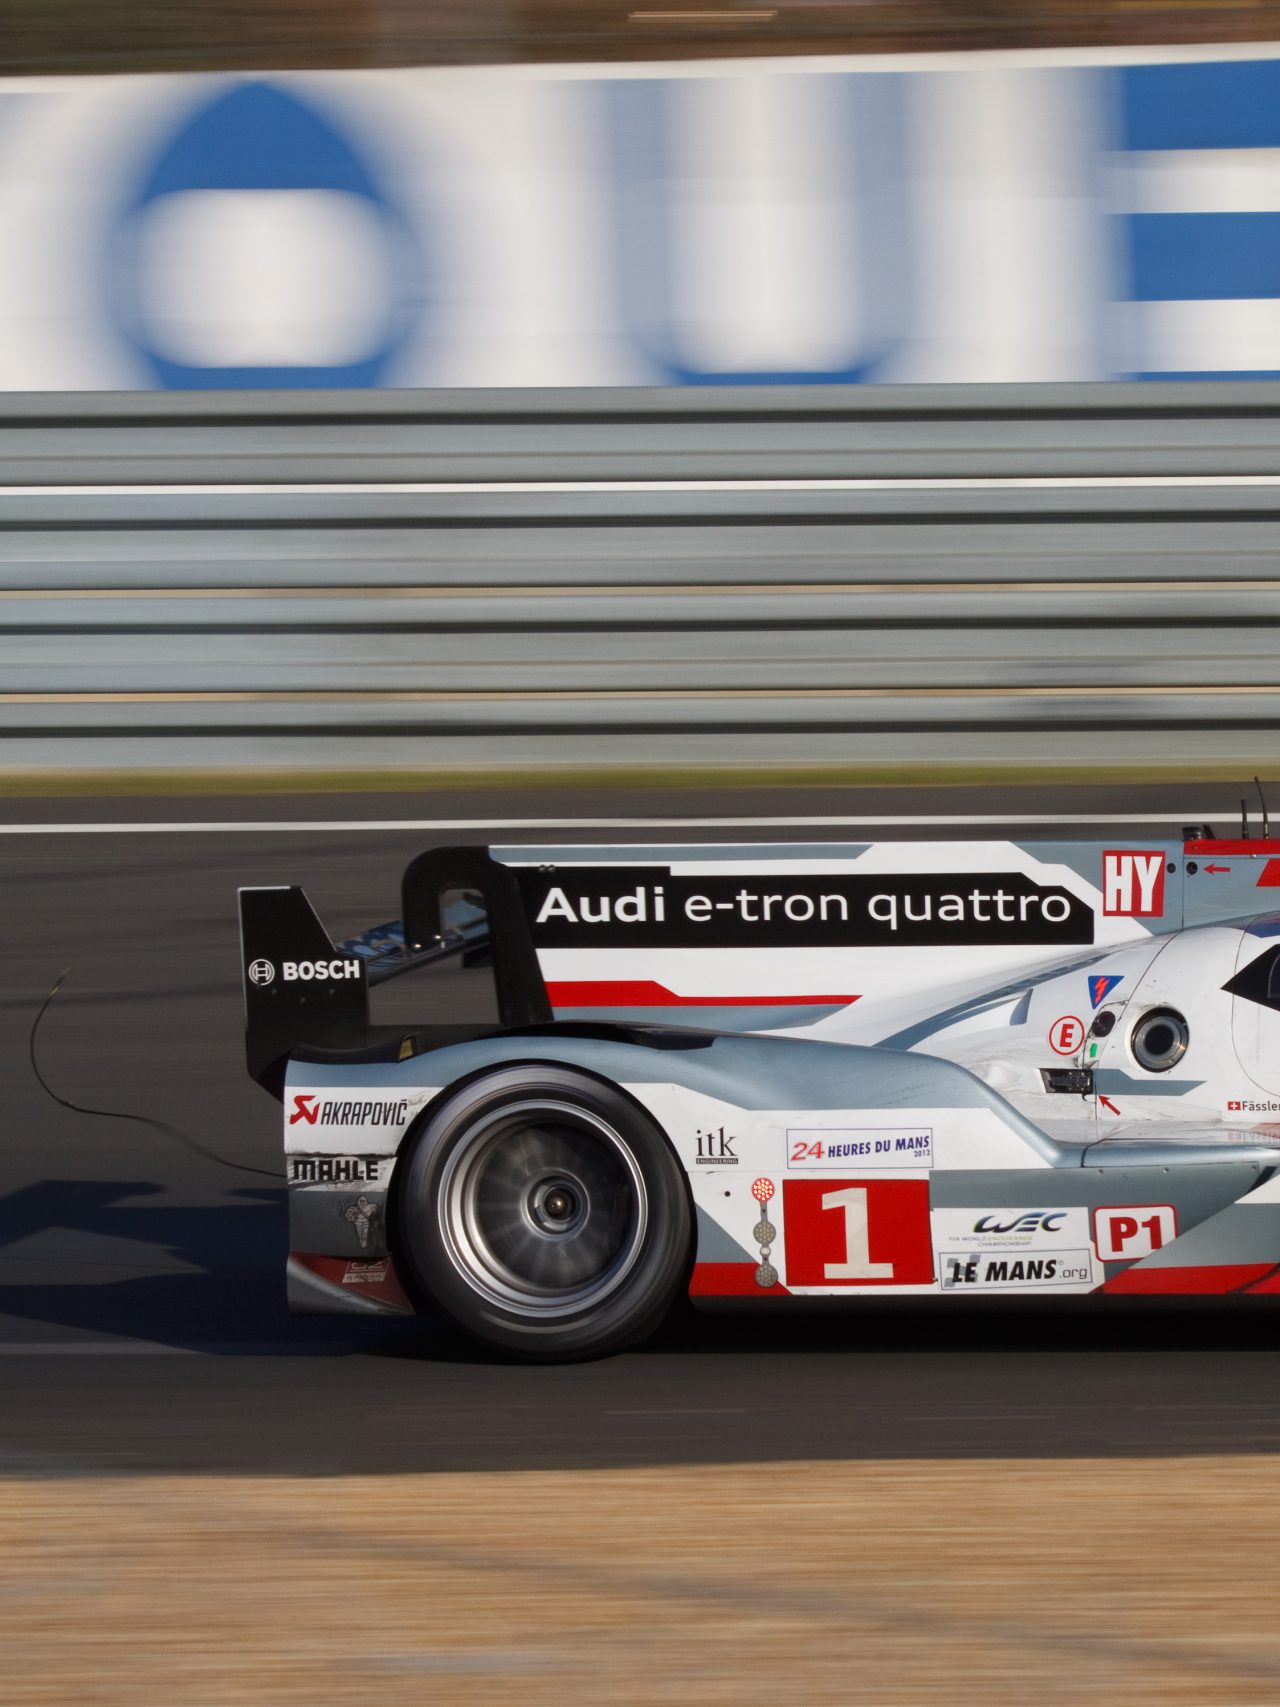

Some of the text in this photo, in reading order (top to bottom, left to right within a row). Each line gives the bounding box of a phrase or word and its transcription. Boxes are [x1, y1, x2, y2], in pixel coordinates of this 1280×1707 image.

[1105, 855, 1162, 912] HY
[536, 886, 1071, 930] Audi e-tron quattro
[283, 959, 360, 981] BOSCH
[1060, 1024, 1075, 1048] E
[695, 1126, 737, 1157] itk
[790, 1135, 930, 1161] 24 HEURES DU MANS
[914, 1149, 931, 1157] 2012
[293, 1159, 379, 1181] MAHLE
[822, 1188, 894, 1279] 1
[973, 1211, 1068, 1233] WEC
[1109, 1215, 1163, 1252] P1
[952, 1262, 978, 1283] LE
